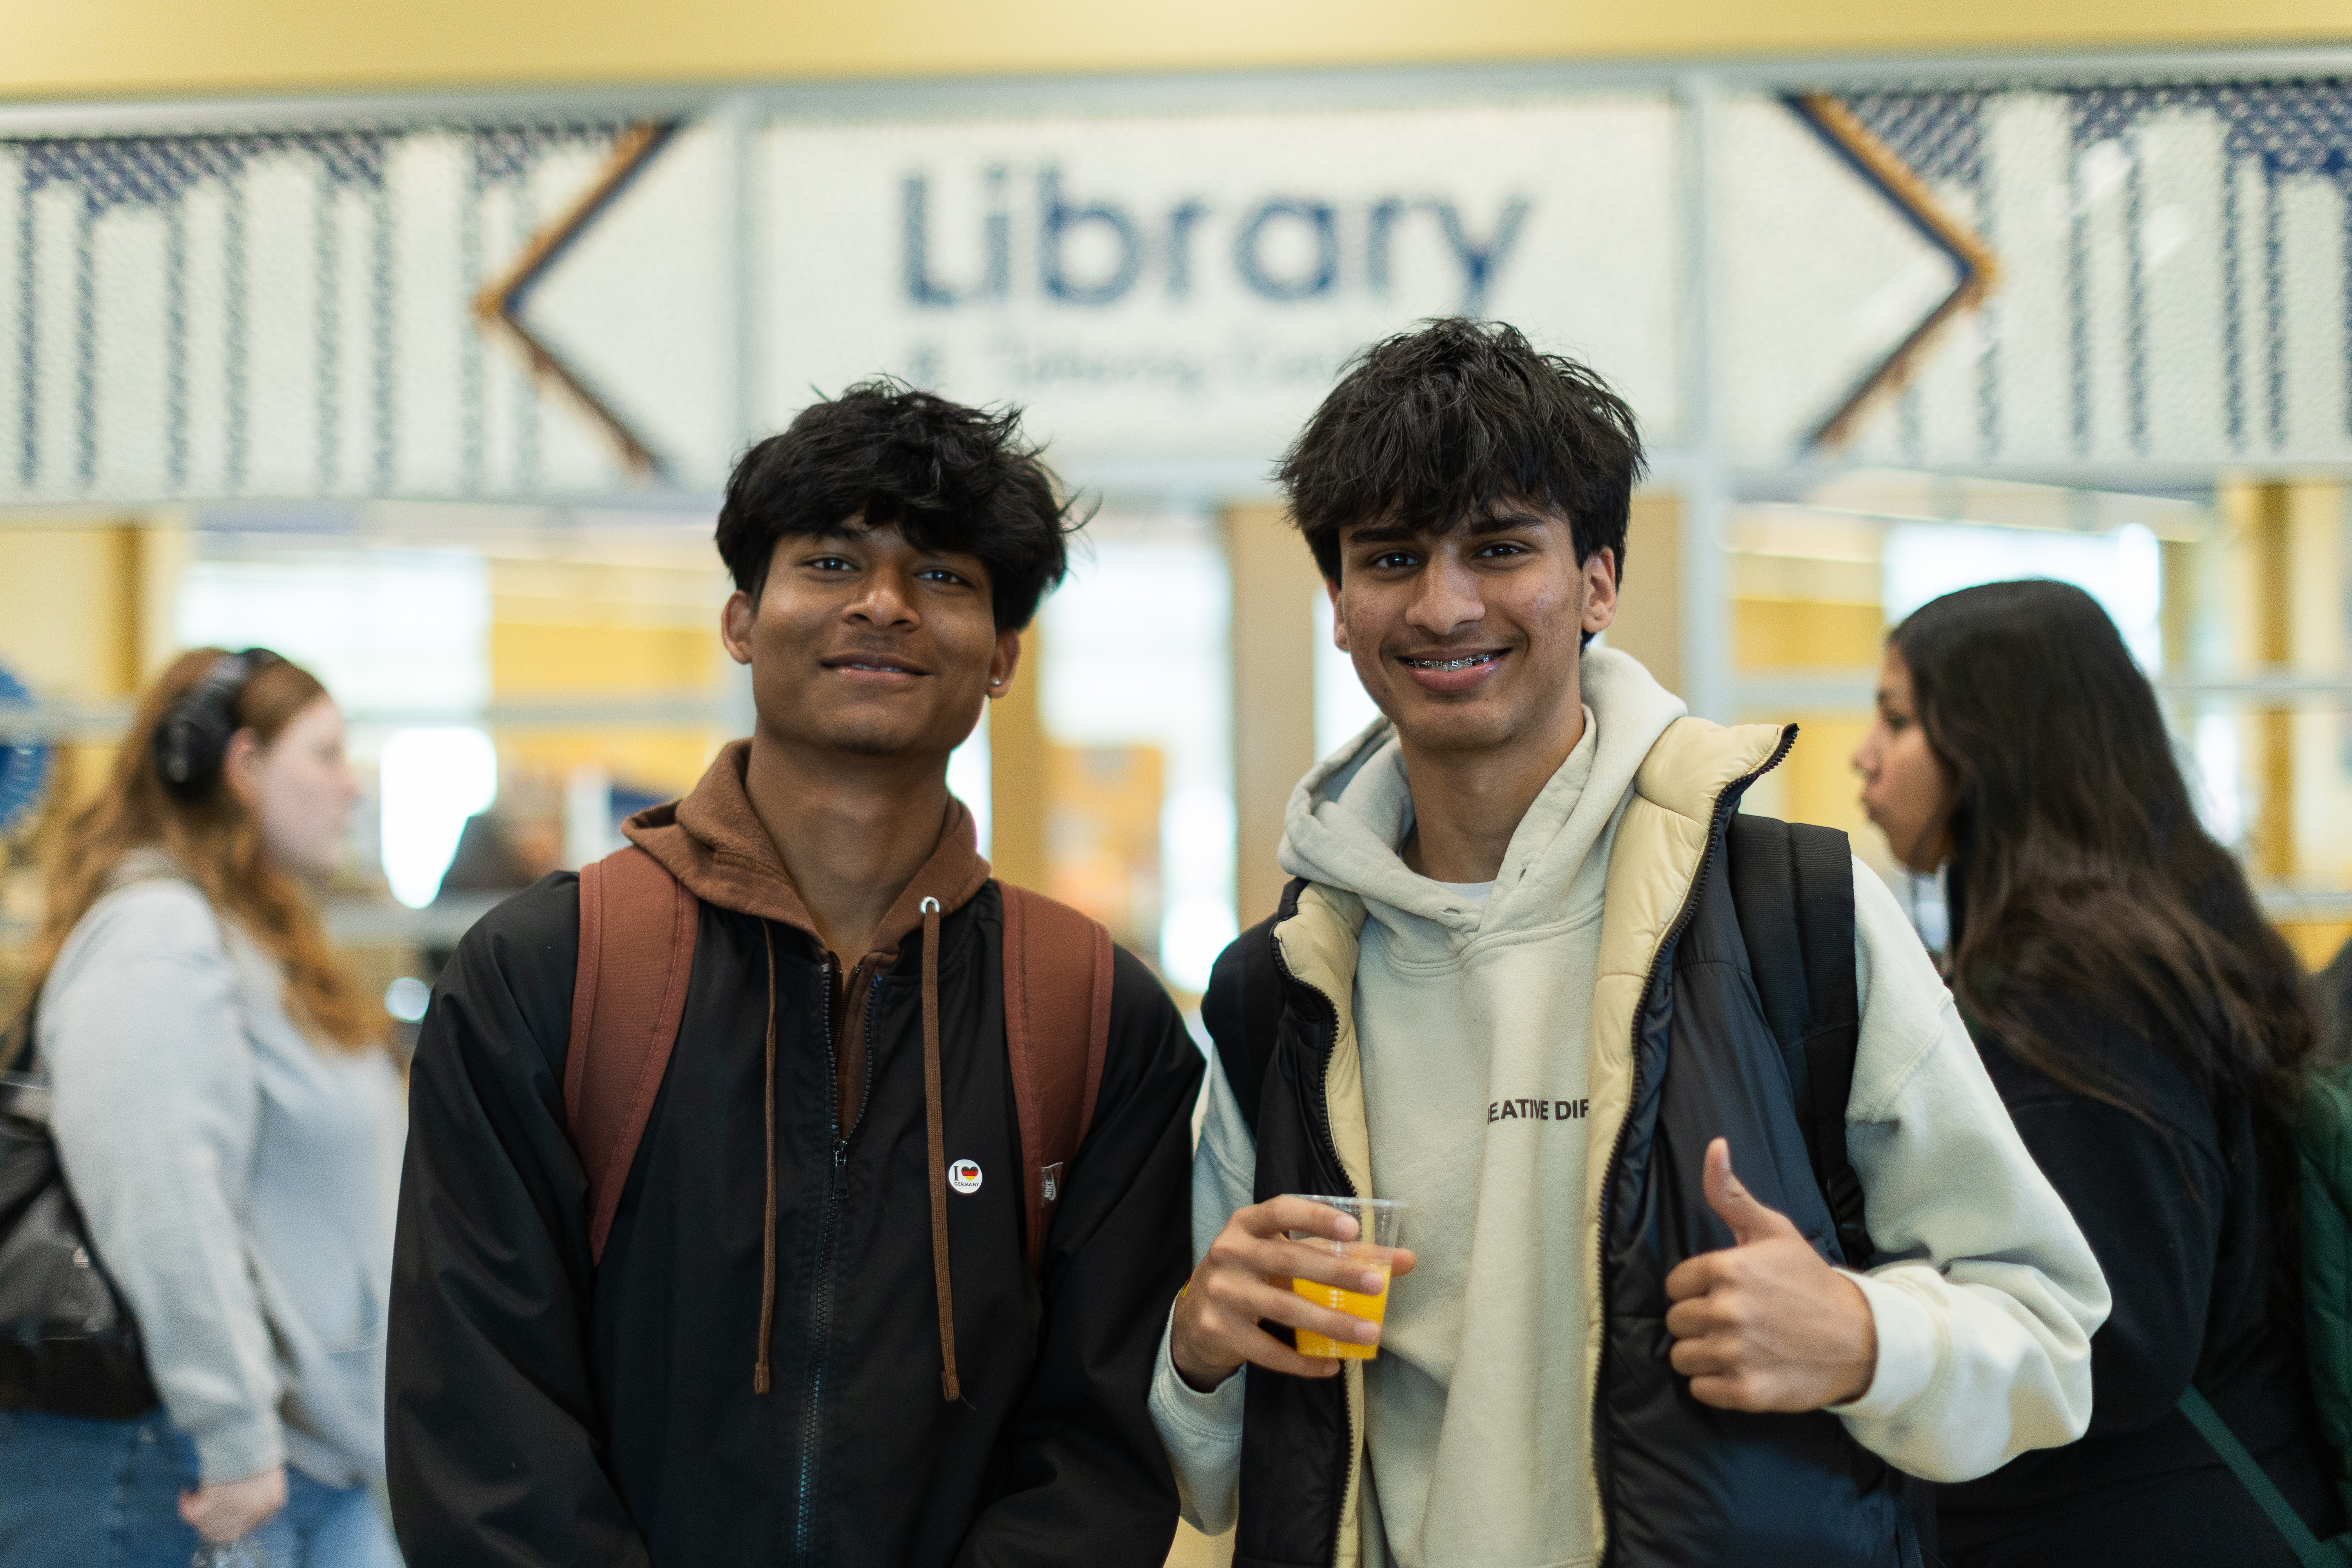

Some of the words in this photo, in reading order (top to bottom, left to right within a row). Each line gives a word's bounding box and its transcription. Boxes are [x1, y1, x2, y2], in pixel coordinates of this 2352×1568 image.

[900, 160, 1533, 313] Library
[1487, 1098, 1549, 1125] EATIVE
[953, 1166, 959, 1181] I
[1044, 1179, 1053, 1198] NIKE
